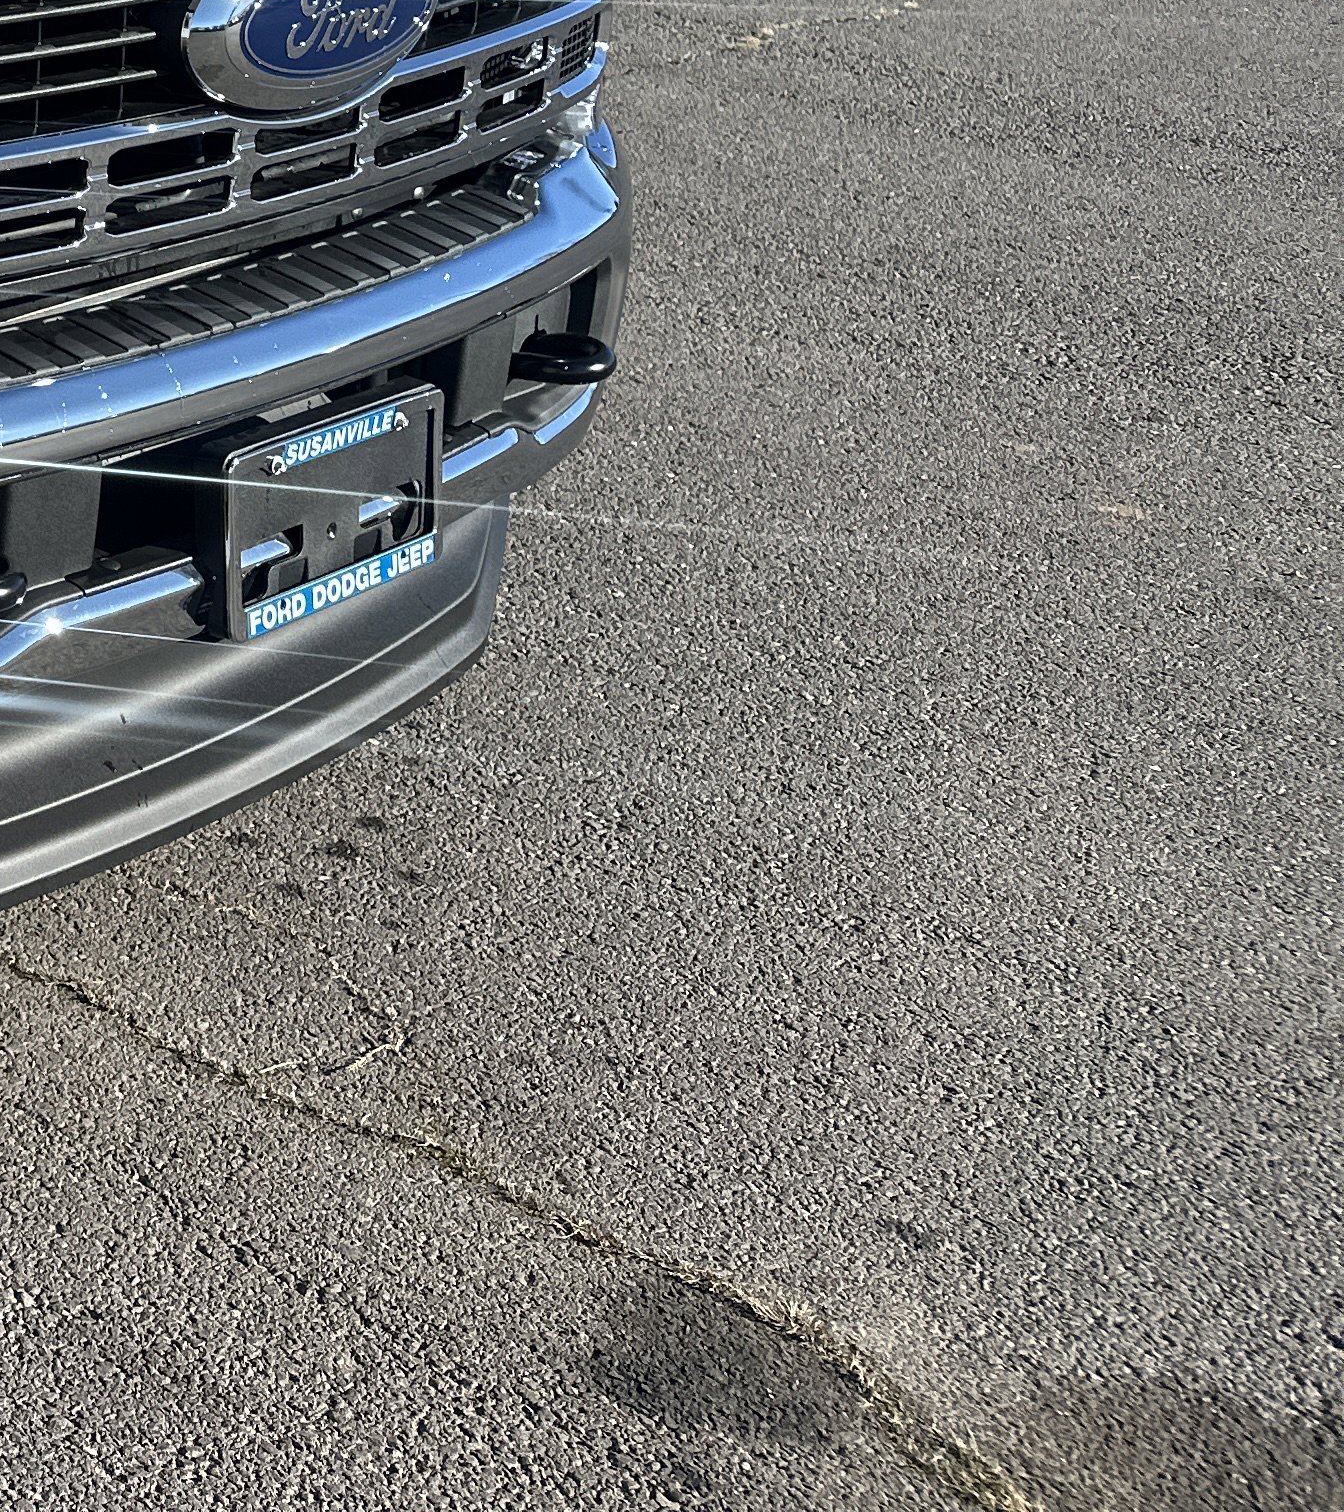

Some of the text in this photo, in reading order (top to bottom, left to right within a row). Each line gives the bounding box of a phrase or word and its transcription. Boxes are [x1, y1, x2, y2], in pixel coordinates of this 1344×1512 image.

[284, 410, 395, 466] SUSANVILLE
[249, 538, 435, 636] FORD DODGE JEEP
